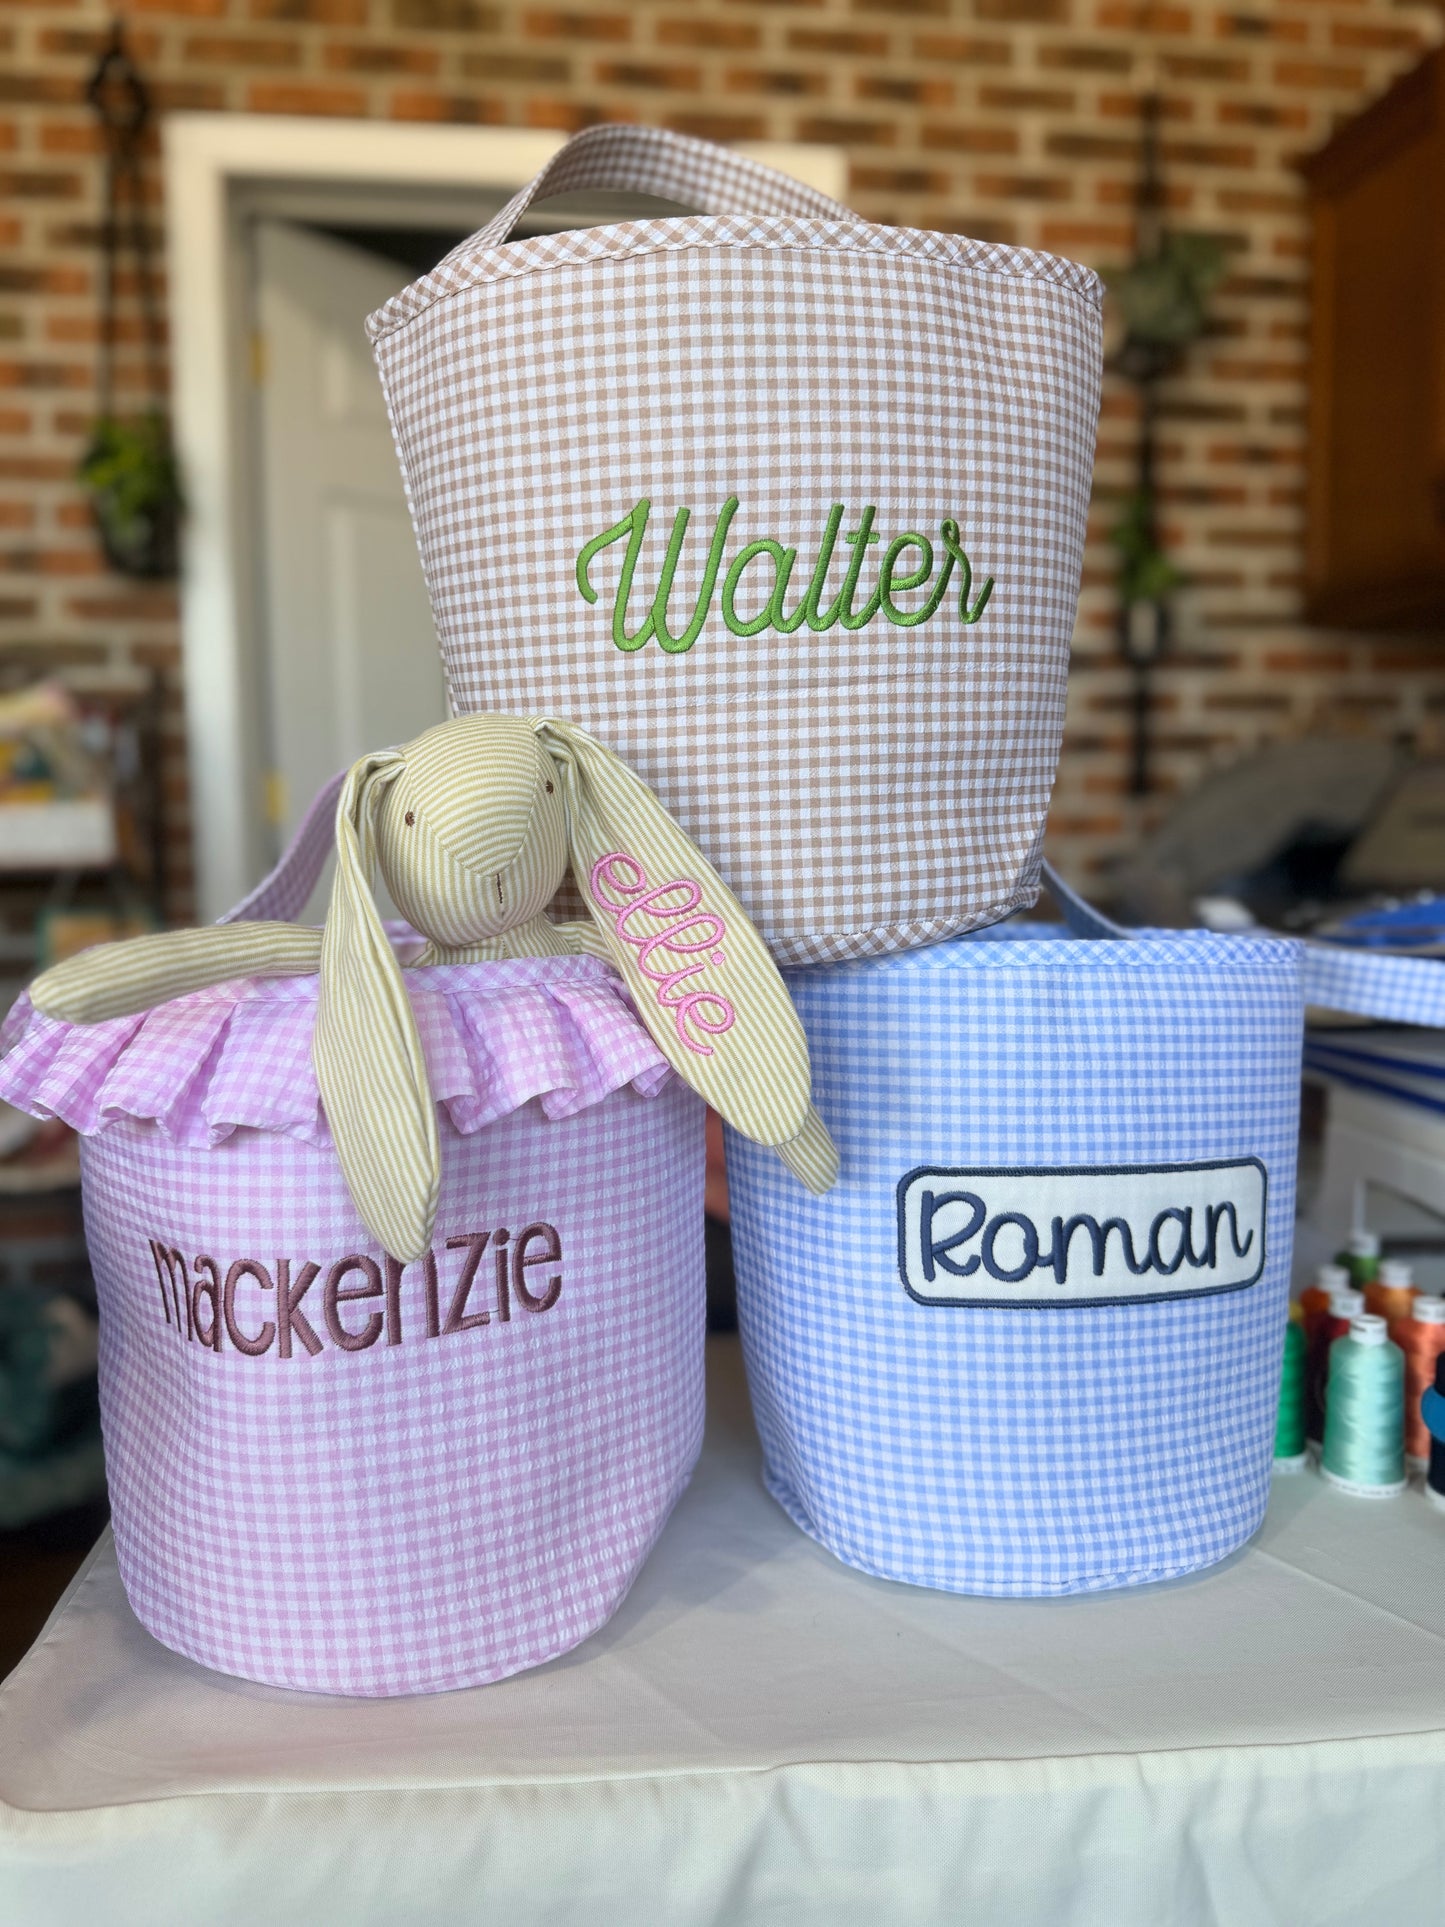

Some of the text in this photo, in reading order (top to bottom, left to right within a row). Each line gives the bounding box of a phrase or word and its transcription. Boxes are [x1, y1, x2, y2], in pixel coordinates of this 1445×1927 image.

[576, 496, 994, 654] Walter
[590, 851, 736, 1056] ellie
[148, 1221, 562, 1359] mackenzie
[920, 1189, 1254, 1285] Roman
